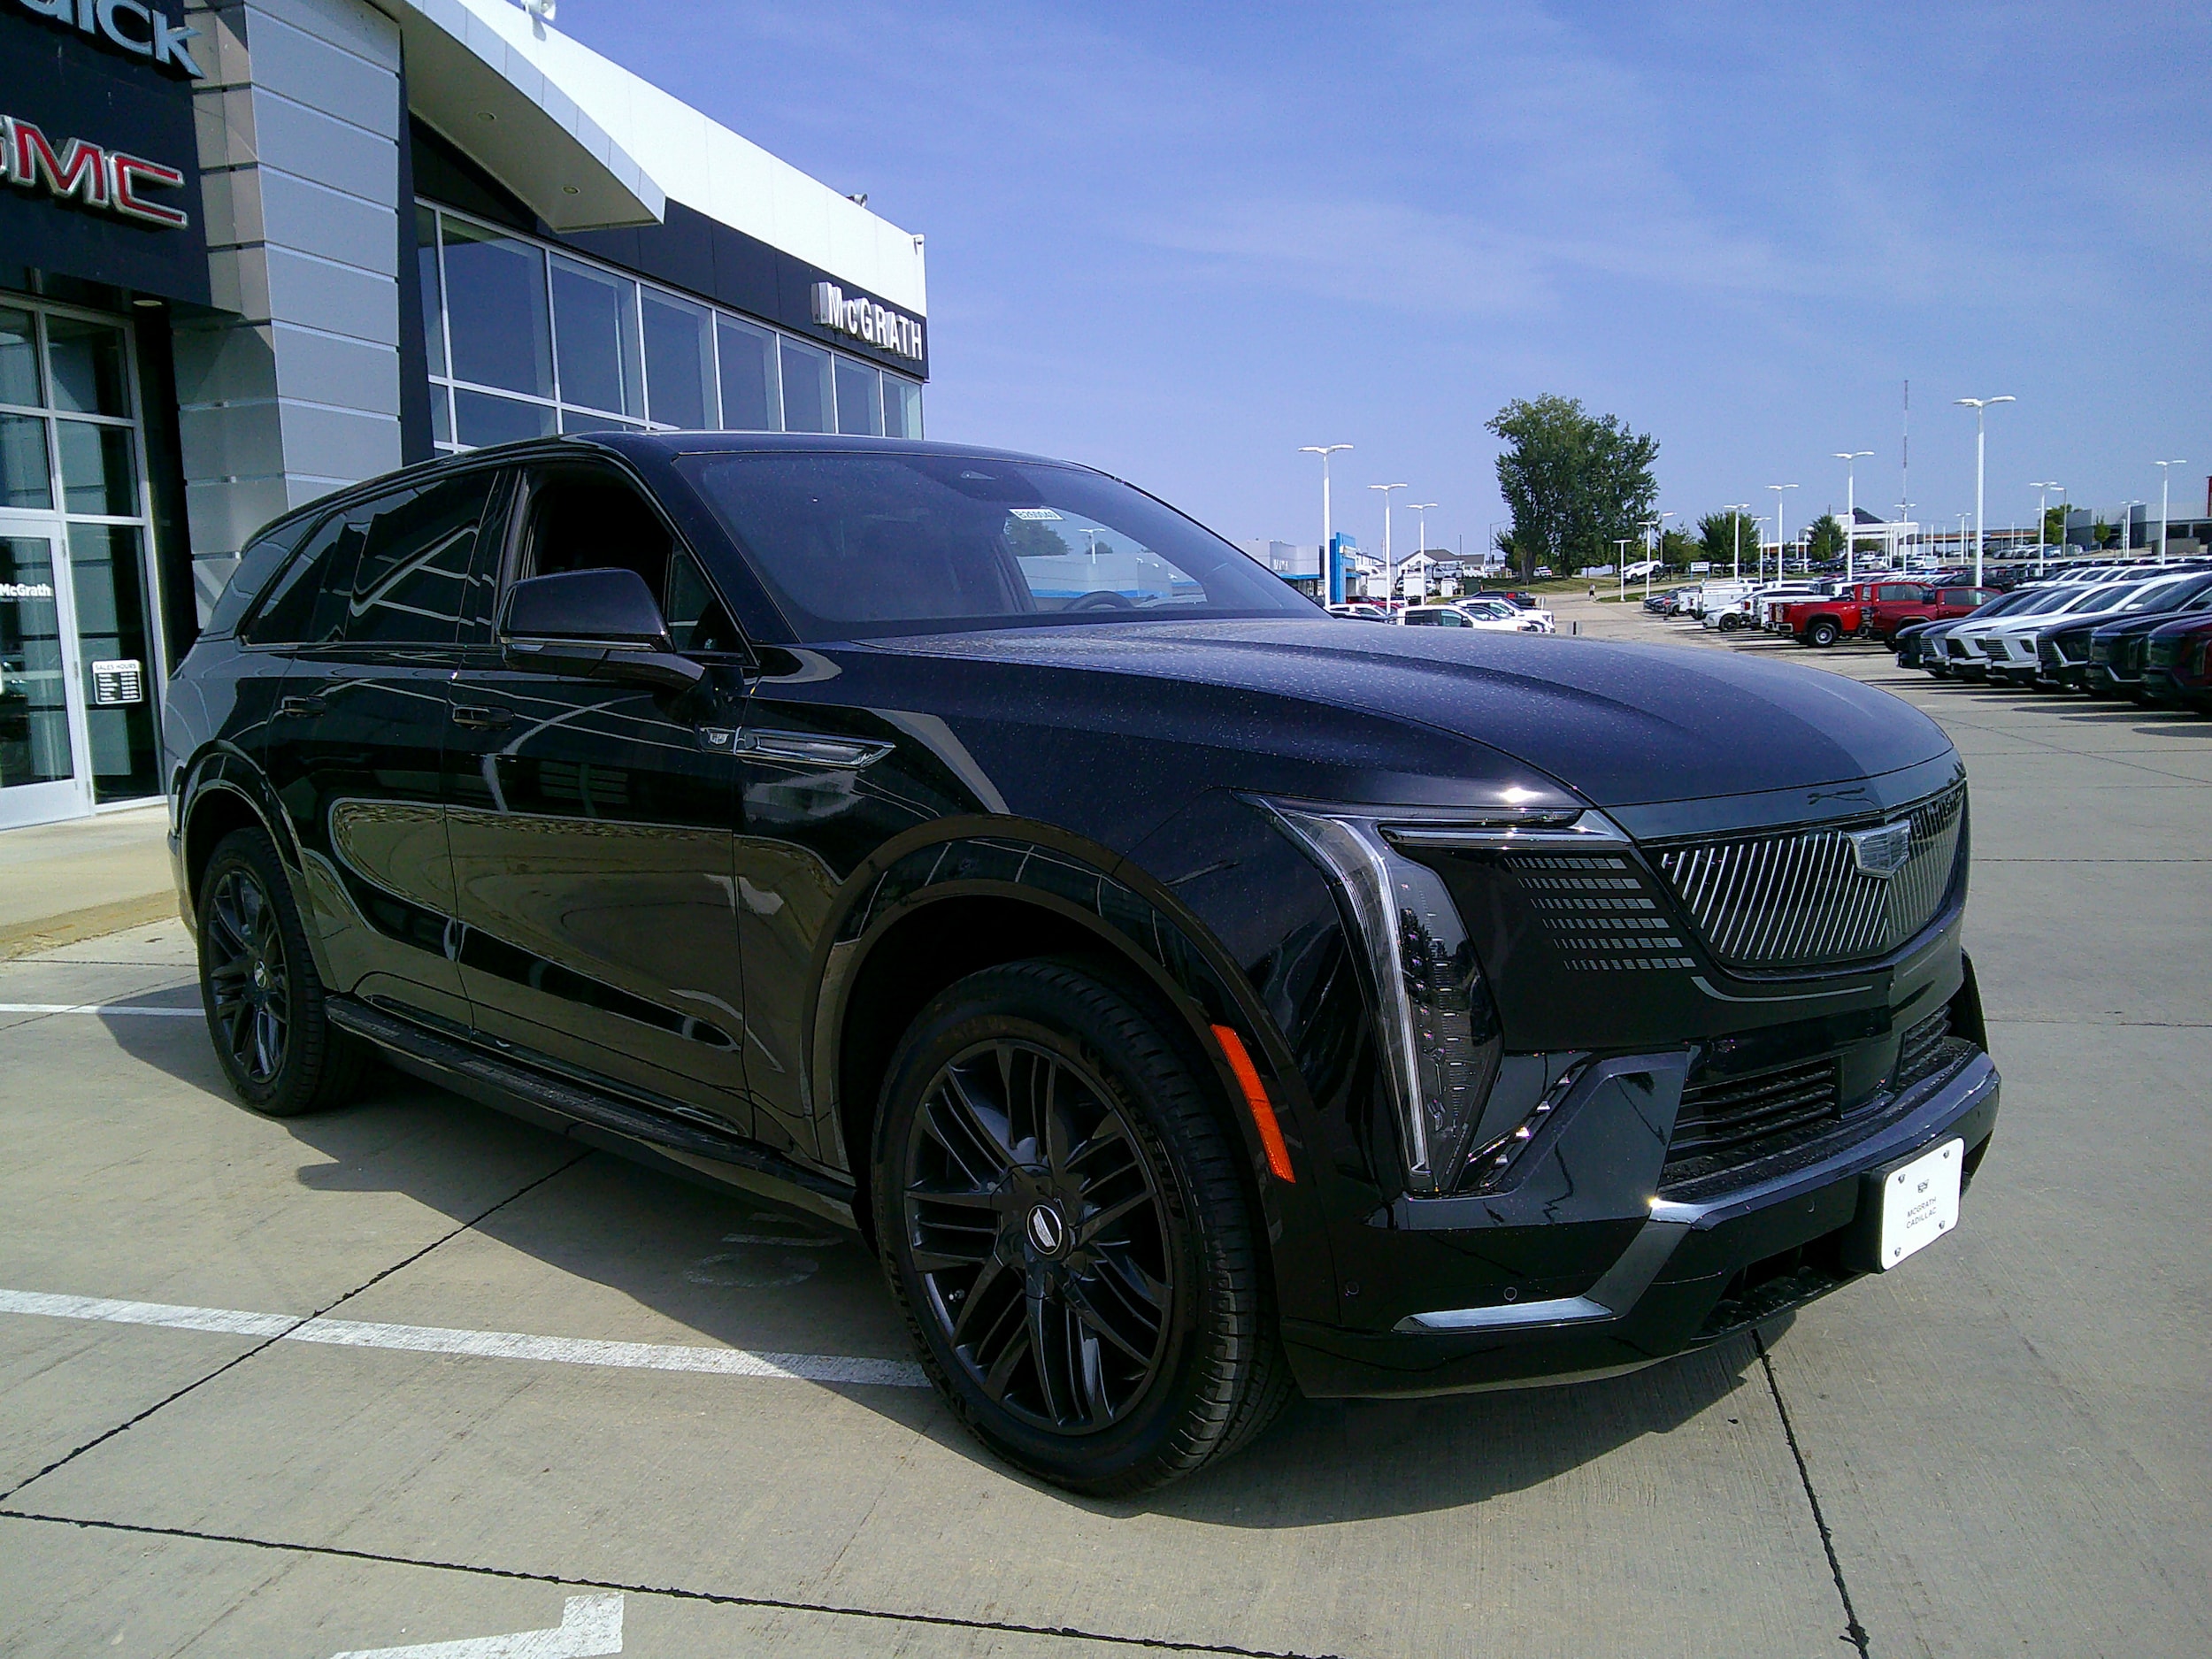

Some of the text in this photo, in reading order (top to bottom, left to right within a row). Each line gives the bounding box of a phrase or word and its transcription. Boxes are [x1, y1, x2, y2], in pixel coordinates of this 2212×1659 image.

[0, 113, 188, 229] MC
[0, 583, 51, 596] McGrath
[1907, 1196, 1937, 1217] MCGRATH
[1907, 1206, 1937, 1229] CADILLAC
